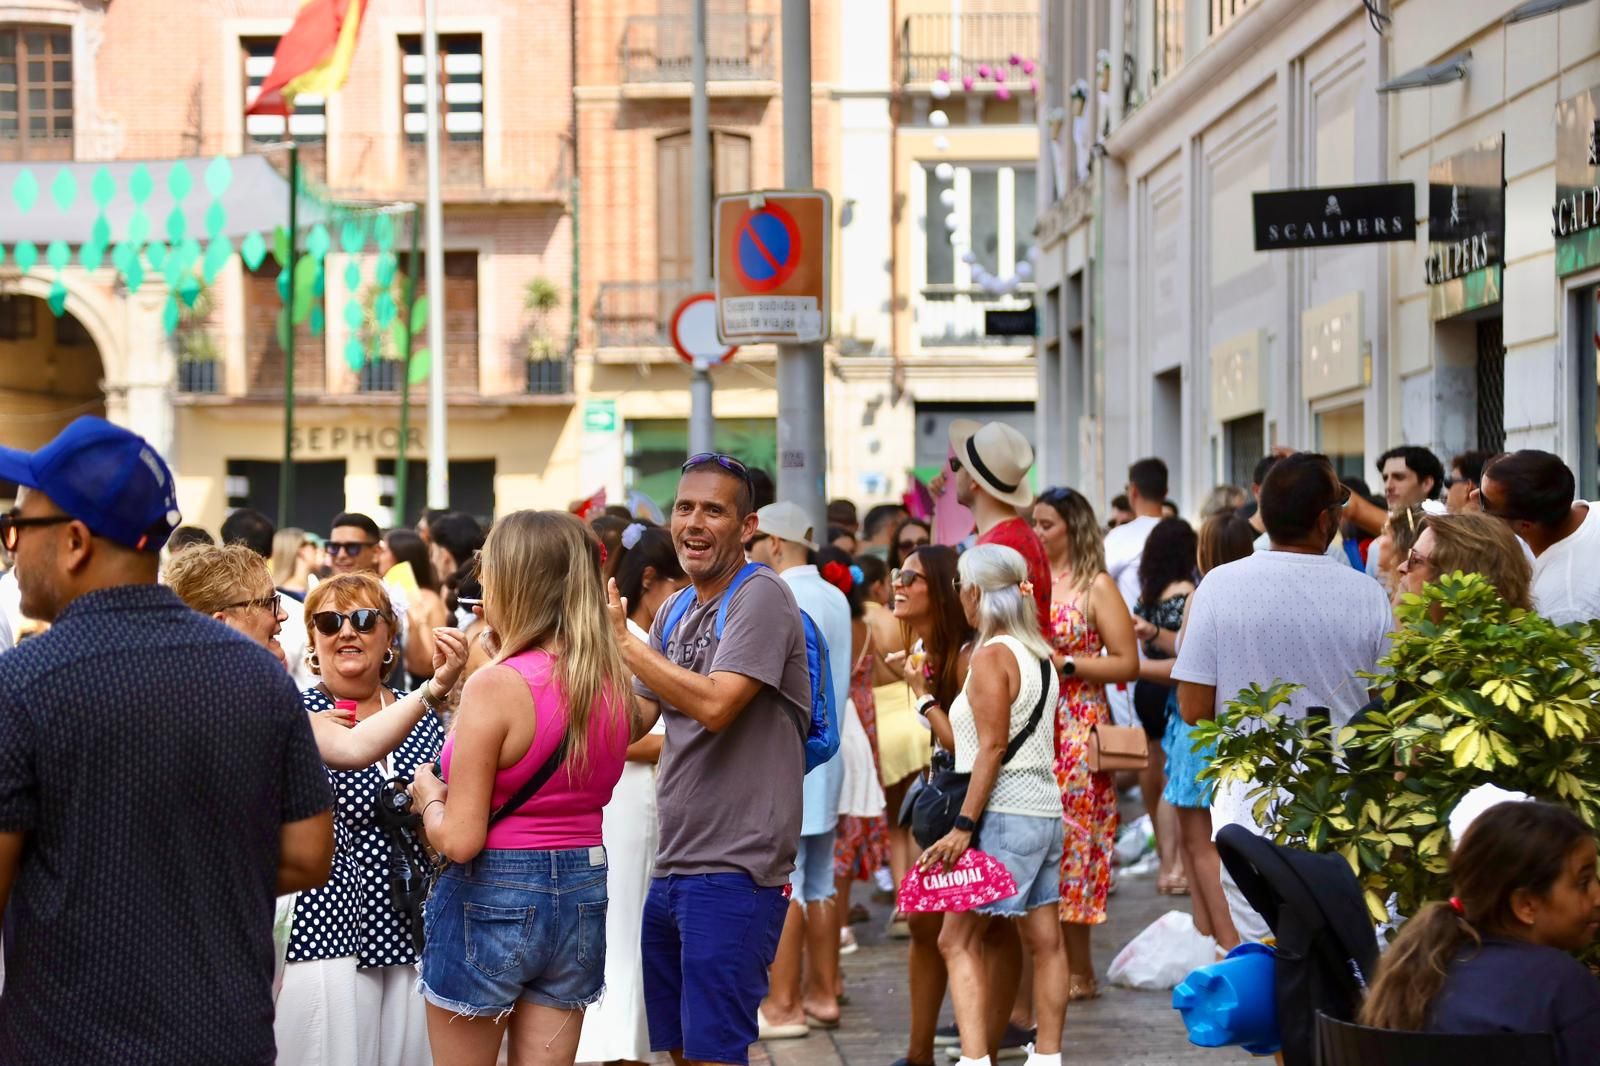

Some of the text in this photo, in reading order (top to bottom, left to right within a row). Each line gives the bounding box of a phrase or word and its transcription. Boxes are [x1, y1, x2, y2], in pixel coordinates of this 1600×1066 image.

[1267, 215, 1403, 241] SCALPERS
[1423, 231, 1488, 285] SCALPERS
[290, 427, 425, 450] SEPHOR
[923, 867, 985, 890] CARTOJAL
